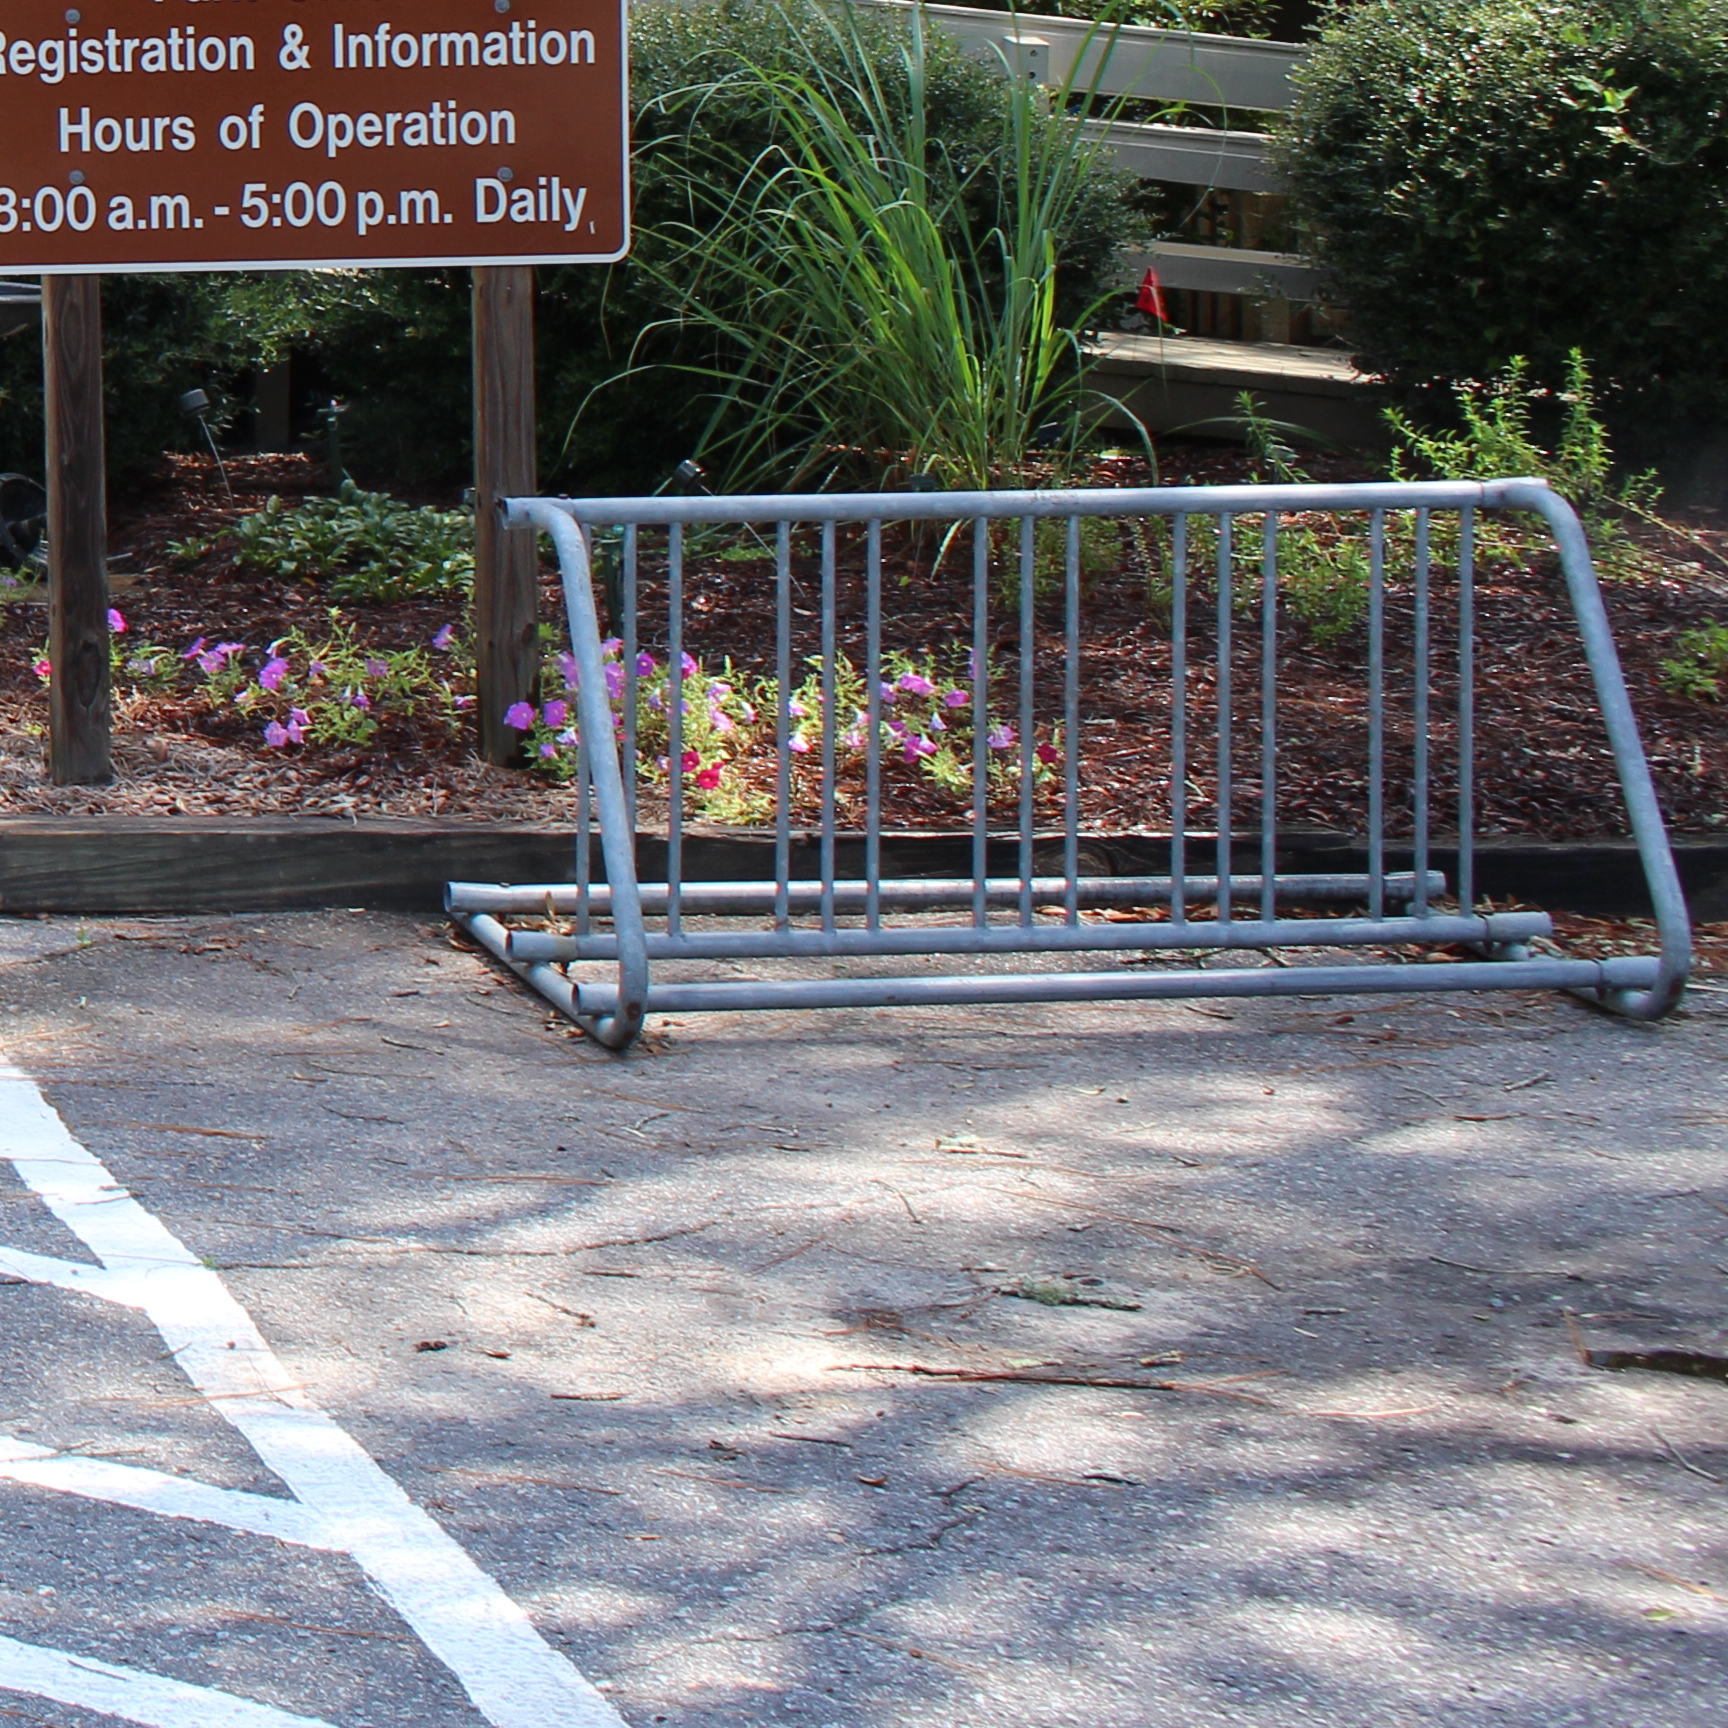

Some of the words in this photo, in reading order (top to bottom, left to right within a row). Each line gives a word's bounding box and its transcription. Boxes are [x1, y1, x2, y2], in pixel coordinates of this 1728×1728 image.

[278, 22, 311, 72] &
[332, 19, 597, 71] Information
[58, 105, 197, 154] Hours
[218, 102, 266, 151] of
[287, 100, 517, 159] Operation
[107, 190, 205, 232] a.m.
[239, 180, 346, 228] 5:00
[355, 185, 454, 236] p.m.
[474, 176, 588, 232] Daily
